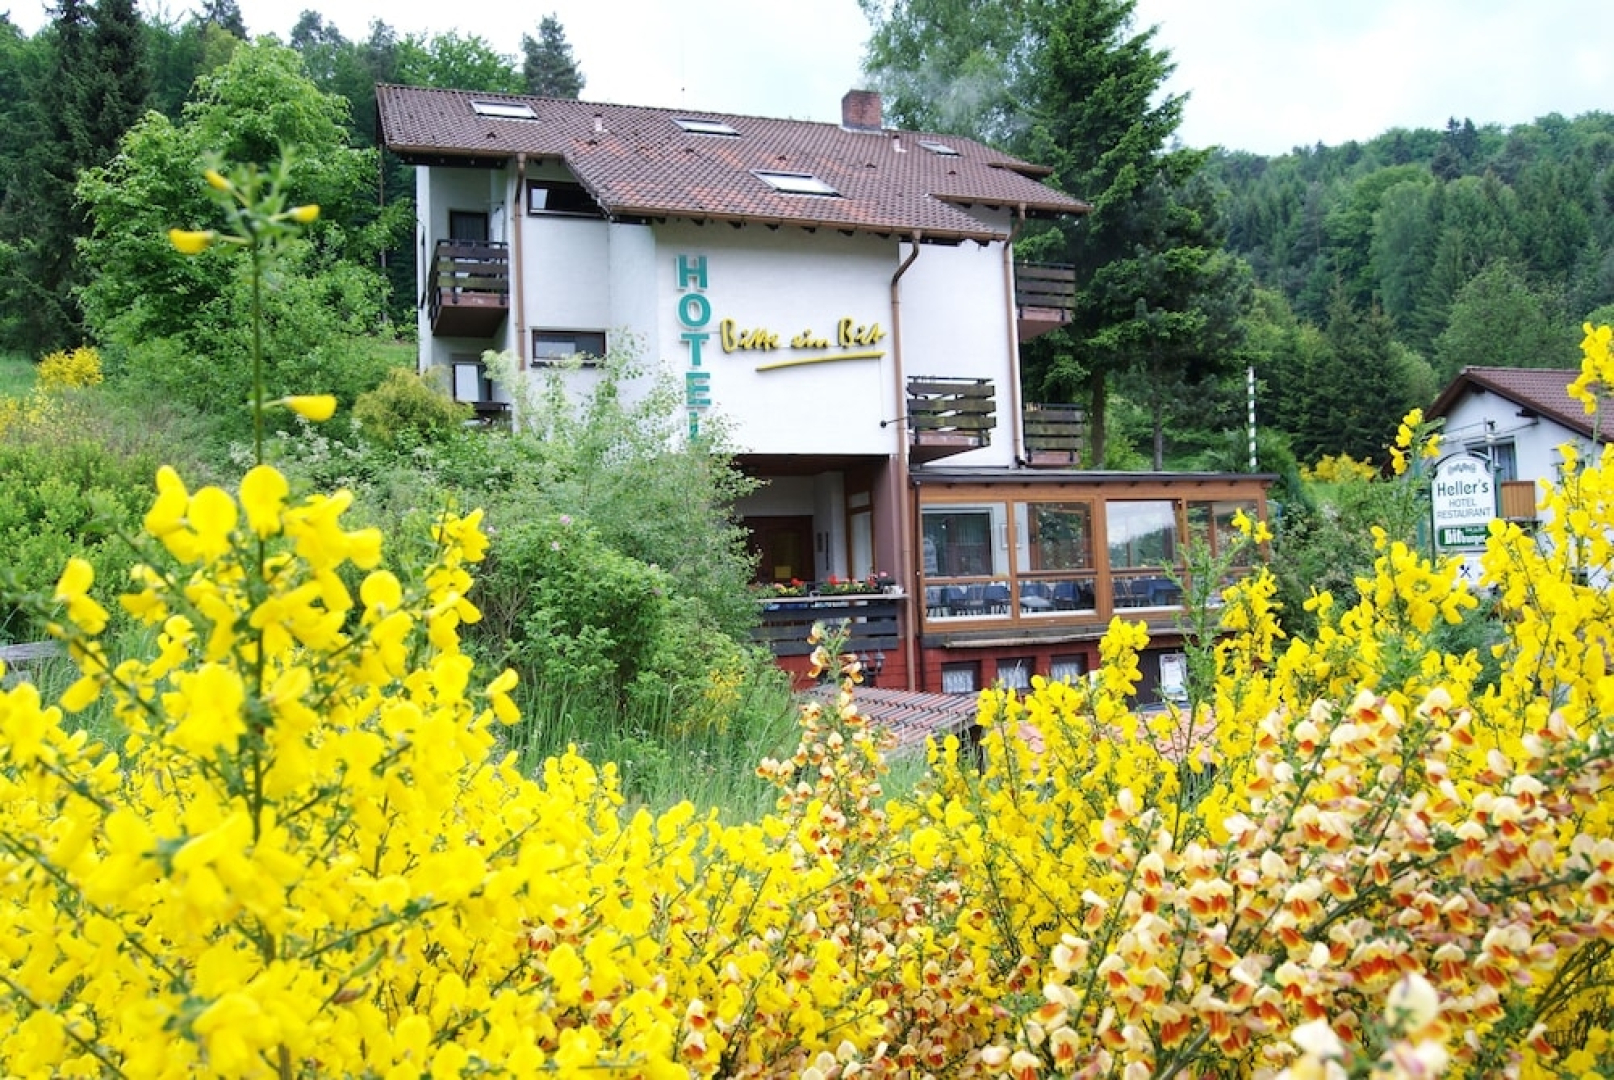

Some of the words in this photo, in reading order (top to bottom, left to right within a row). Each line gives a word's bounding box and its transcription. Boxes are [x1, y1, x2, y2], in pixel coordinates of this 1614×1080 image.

[720, 318, 780, 354] Bitte
[791, 329, 831, 349] ein
[838, 317, 887, 349] Bit
[1437, 478, 1489, 497] Heller's
[1449, 498, 1477, 508] HOTEL
[1436, 507, 1491, 519] RESTAURANT
